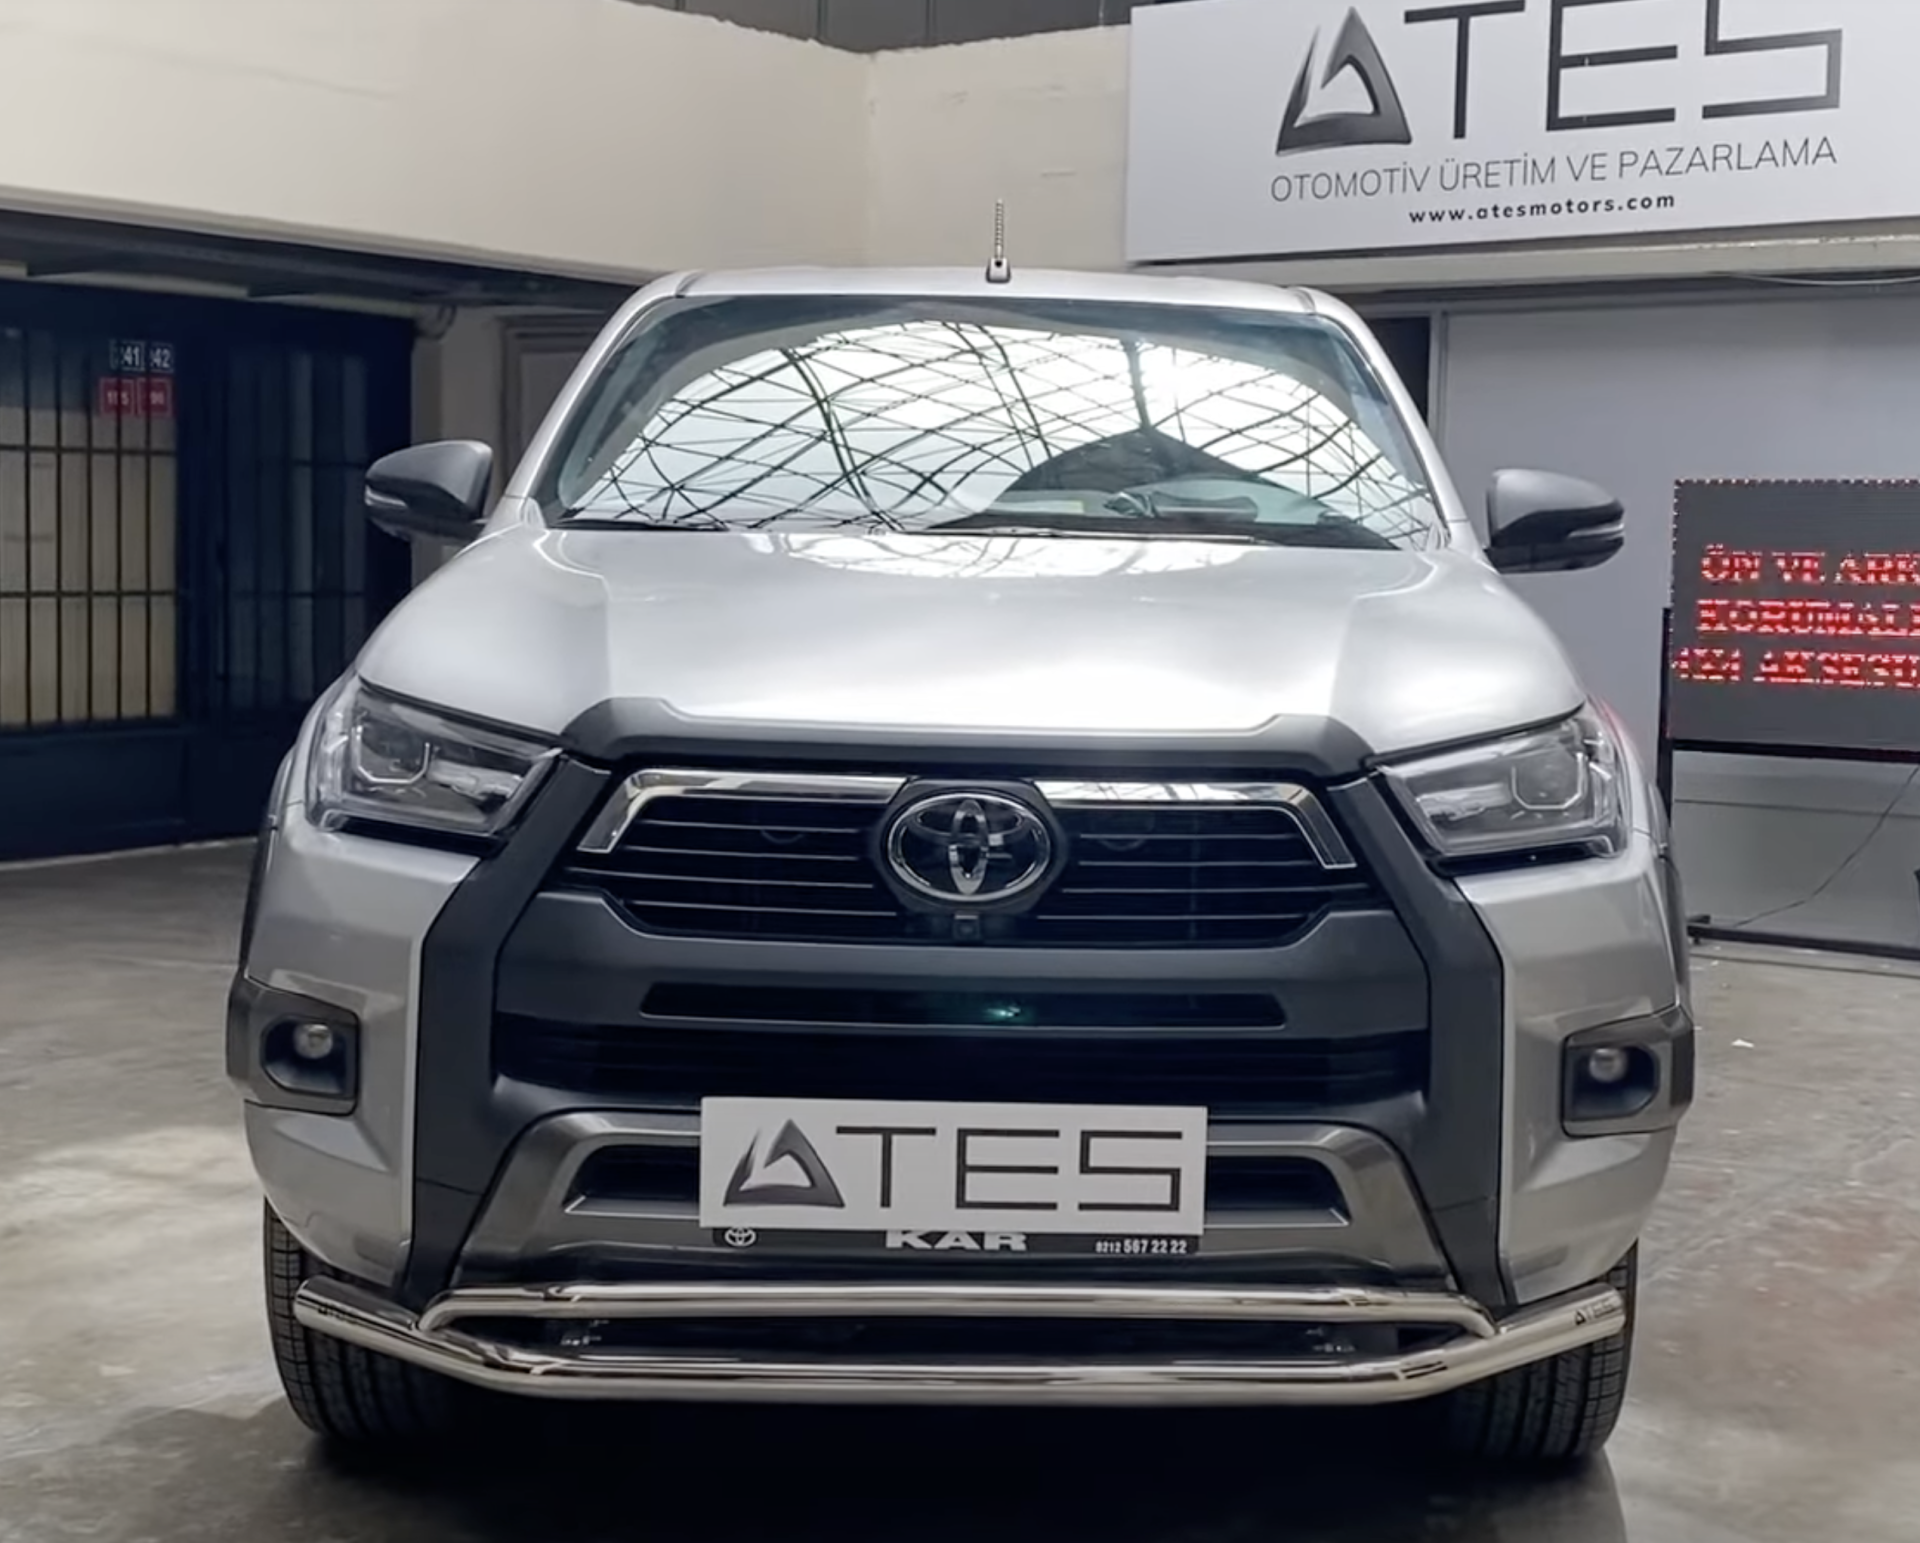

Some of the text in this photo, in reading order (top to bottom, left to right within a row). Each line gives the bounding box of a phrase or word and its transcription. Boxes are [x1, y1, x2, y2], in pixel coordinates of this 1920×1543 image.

[1276, 0, 1842, 155] ATES
[1271, 136, 1838, 202] OTOMOTİV ÜRETİM VE PAZARLAMA
[1409, 194, 1676, 223] www.atesmotors.com
[1701, 543, 1760, 584] ÖN
[1770, 551, 1826, 583] VE
[723, 1117, 1183, 1212] ATES
[885, 1229, 1027, 1251] KAR
[1123, 1238, 1148, 1254] 567
[1150, 1239, 1168, 1254] 22
[1169, 1239, 1187, 1254] 22
